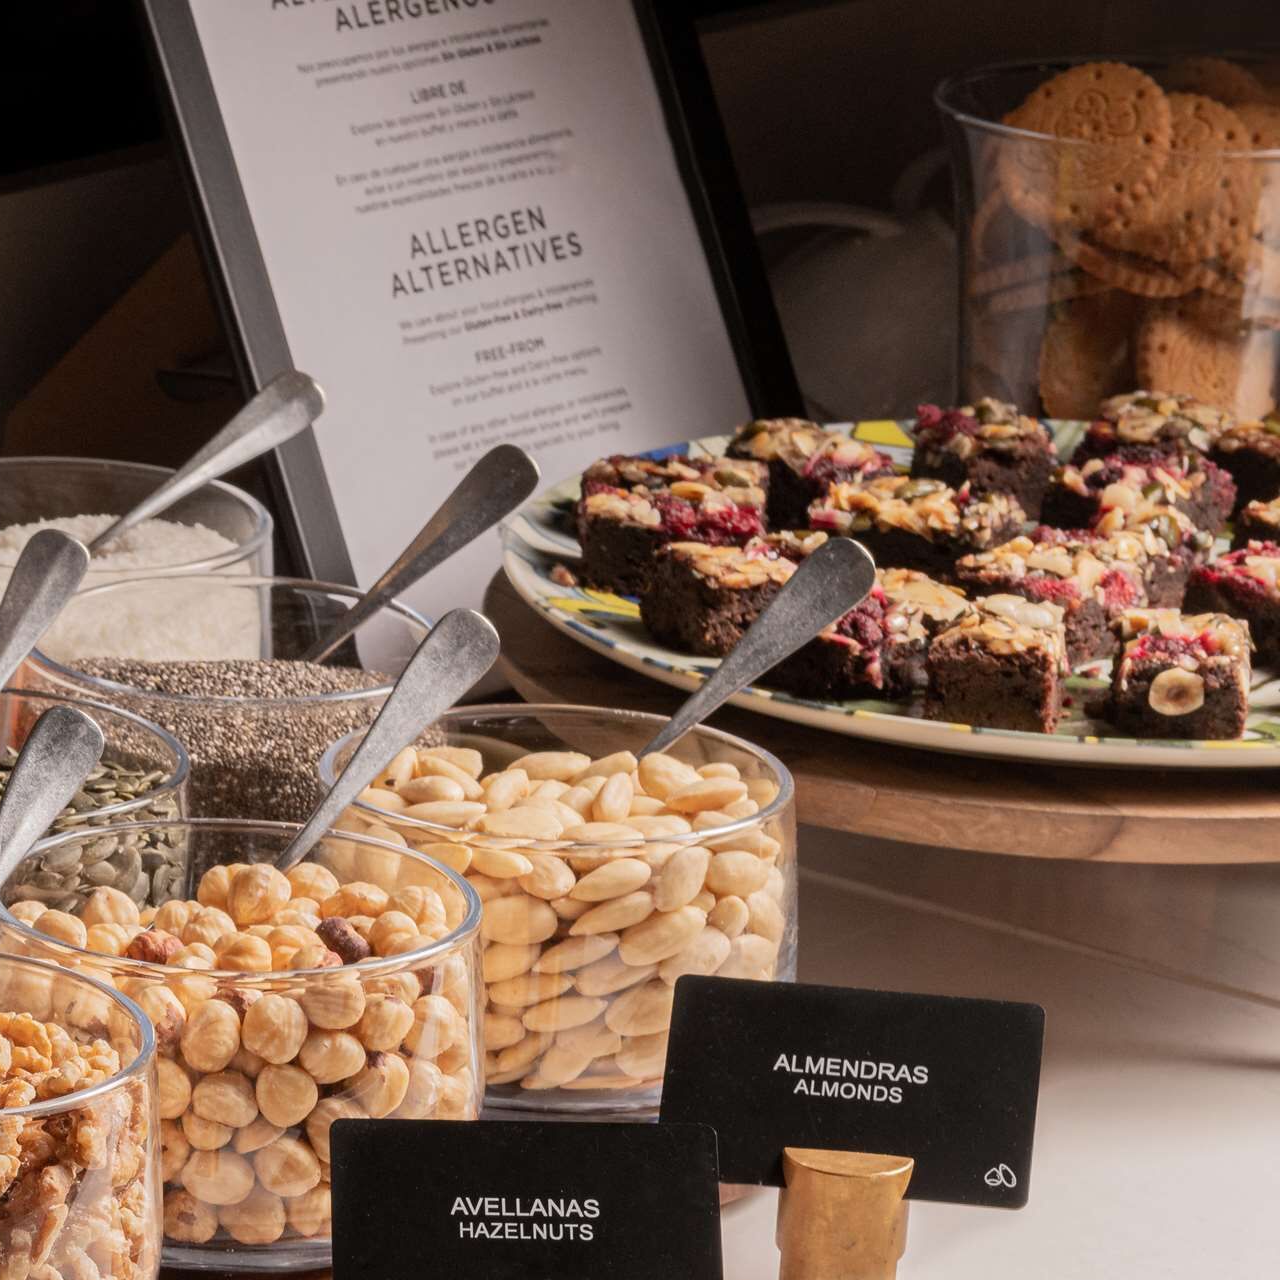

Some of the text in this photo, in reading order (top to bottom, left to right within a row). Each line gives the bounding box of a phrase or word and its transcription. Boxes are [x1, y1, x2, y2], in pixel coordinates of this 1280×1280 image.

[335, 0, 496, 31] ALERGEN
[410, 80, 467, 104] LIBRE DE
[410, 205, 548, 260] ALLERGEN
[392, 231, 583, 299] ALTERNATIVES
[475, 337, 545, 362] FREE-FROM
[773, 1053, 929, 1084] ALMENDRAS
[793, 1078, 903, 1104] ALMONDS
[450, 1196, 600, 1218] AVELLANAS
[458, 1221, 594, 1241] HAZELNUTS
